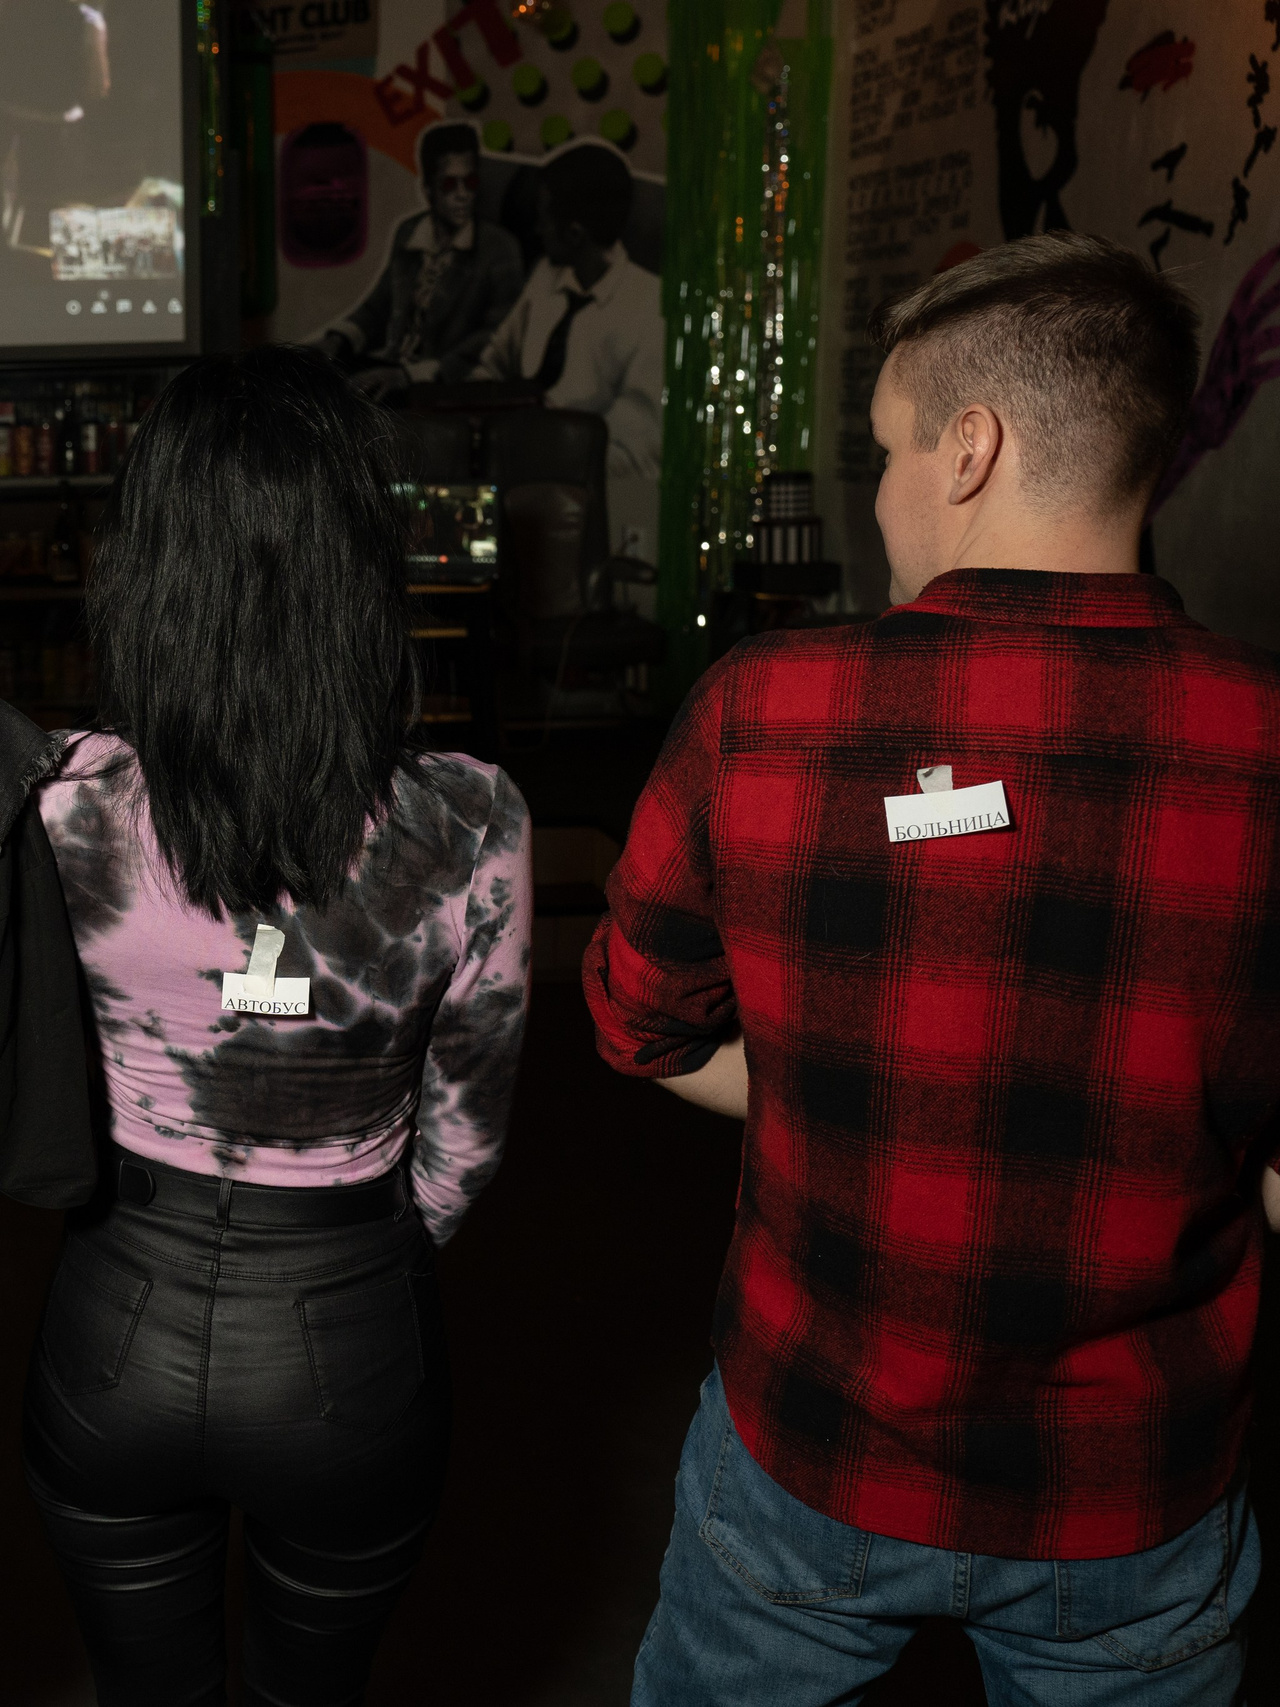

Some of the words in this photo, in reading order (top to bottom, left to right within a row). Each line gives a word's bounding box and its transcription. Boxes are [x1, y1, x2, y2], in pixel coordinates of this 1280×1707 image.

[300, 0, 370, 29] CLUB
[374, 0, 523, 127] EXIT
[894, 811, 1007, 841] БОЛЬНИЦА
[224, 998, 306, 1014] АВТОБУС
